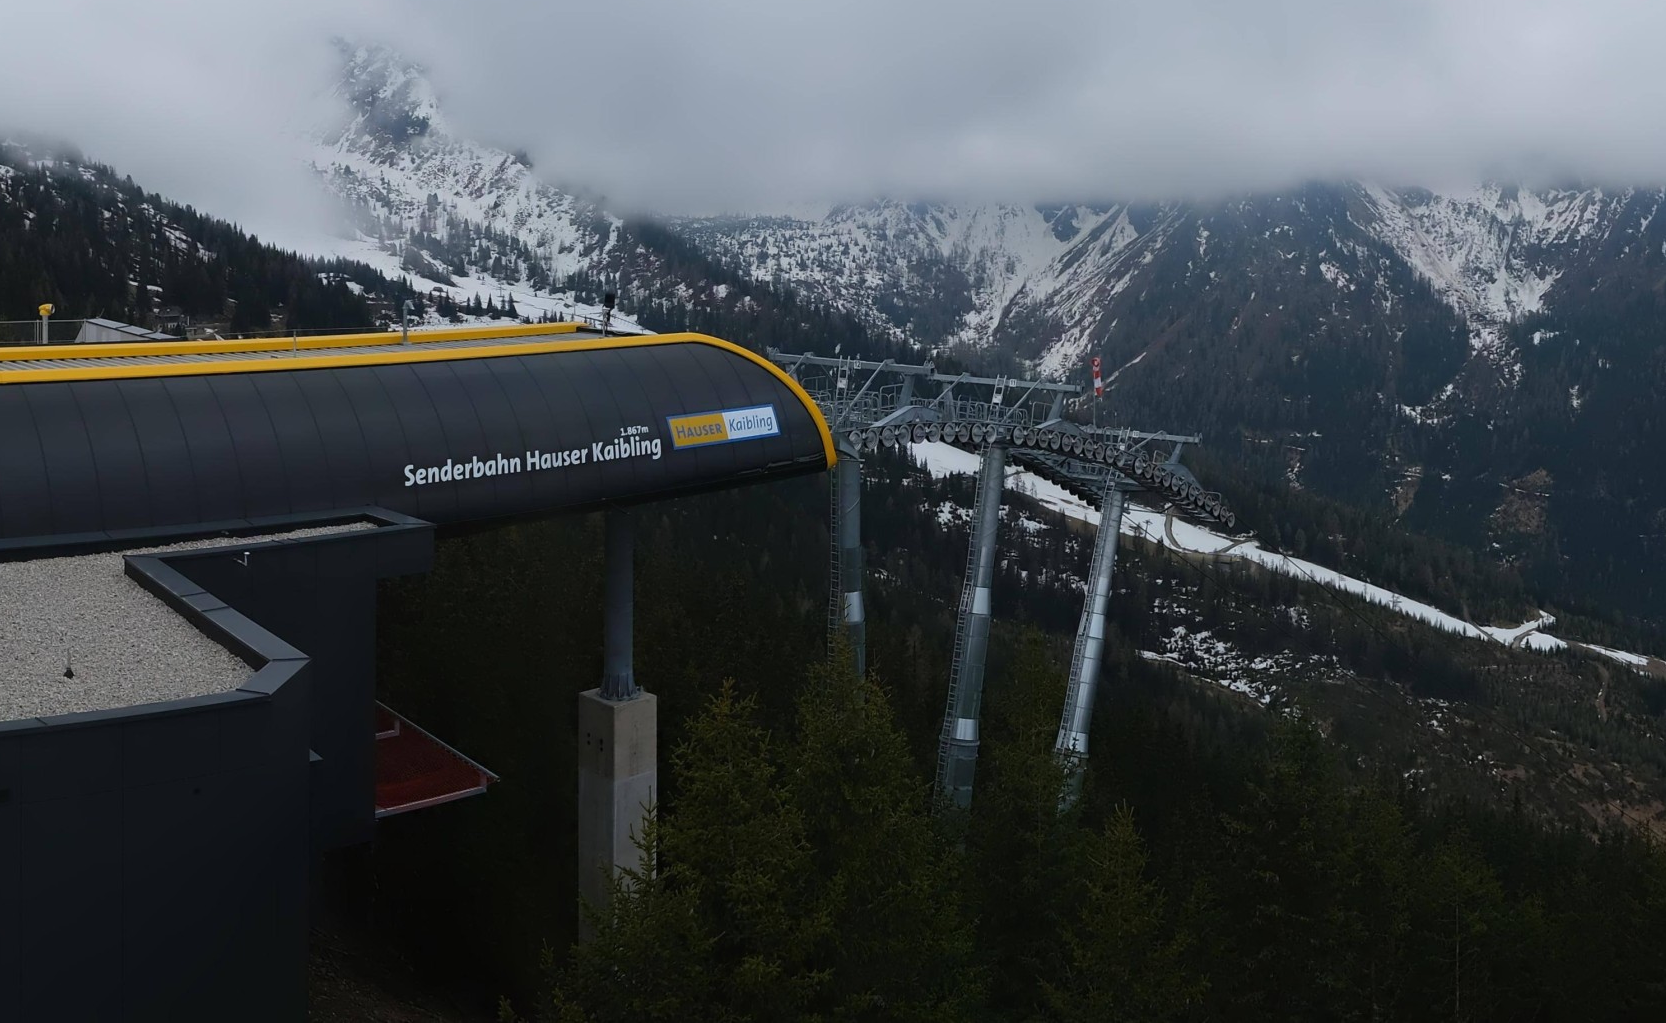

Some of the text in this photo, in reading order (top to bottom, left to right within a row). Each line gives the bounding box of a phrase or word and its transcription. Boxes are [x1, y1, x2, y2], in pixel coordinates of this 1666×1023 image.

[620, 425, 649, 436] 1.867m
[676, 415, 773, 439] HAUSER Kaibling
[404, 437, 662, 486] Senderbahn Hauser Kaibling
